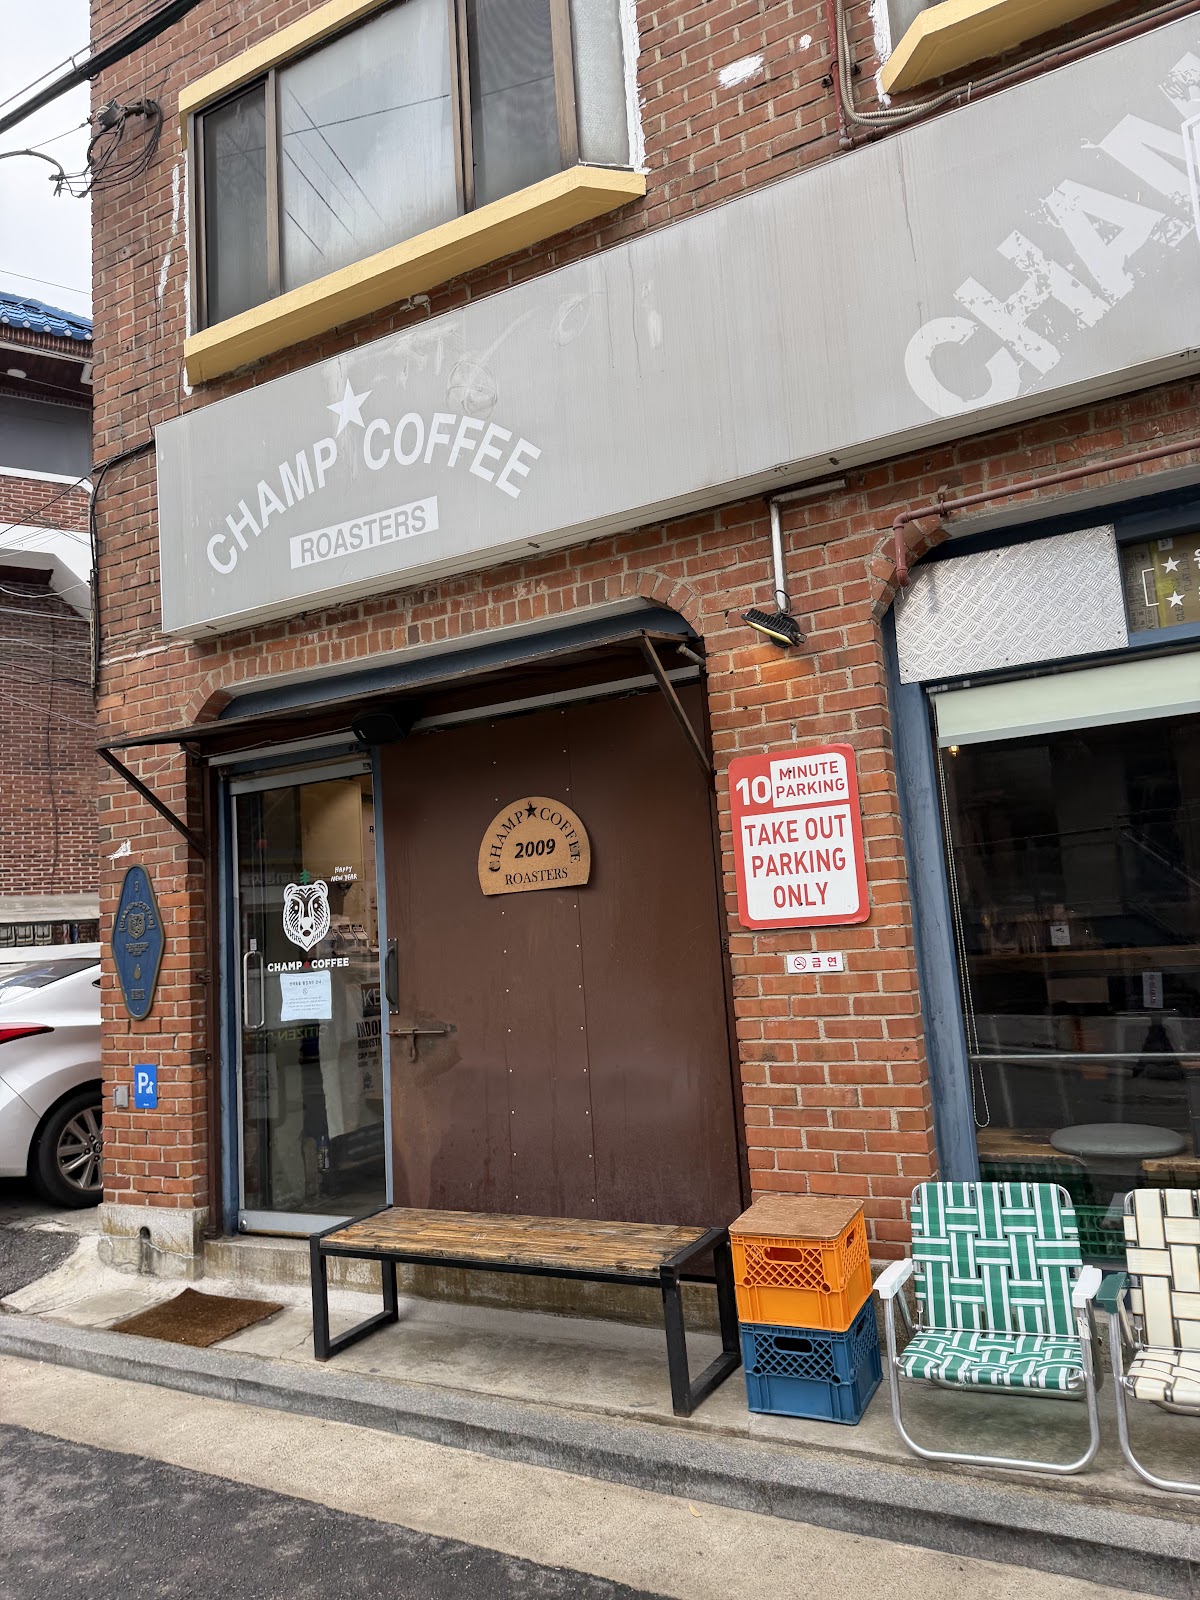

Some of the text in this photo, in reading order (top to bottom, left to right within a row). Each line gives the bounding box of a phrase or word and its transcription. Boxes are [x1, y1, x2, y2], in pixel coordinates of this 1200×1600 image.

[206, 412, 542, 575] CHAMP COFFEE
[299, 504, 428, 564] ROASTERS
[779, 760, 839, 782] MINUTE
[735, 775, 773, 806] 10
[776, 777, 845, 799] PARKING
[488, 807, 581, 873] CHAMP COFFEE
[744, 814, 847, 847] TAKE OUT
[514, 838, 556, 859] 2009
[334, 866, 353, 874] HAPPY
[751, 847, 846, 878] PARKING
[330, 873, 358, 883] NEW YEAR
[505, 867, 568, 886] ROASTERS
[773, 881, 829, 909] ONLY
[267, 957, 350, 972] CHAMP COFFEE
